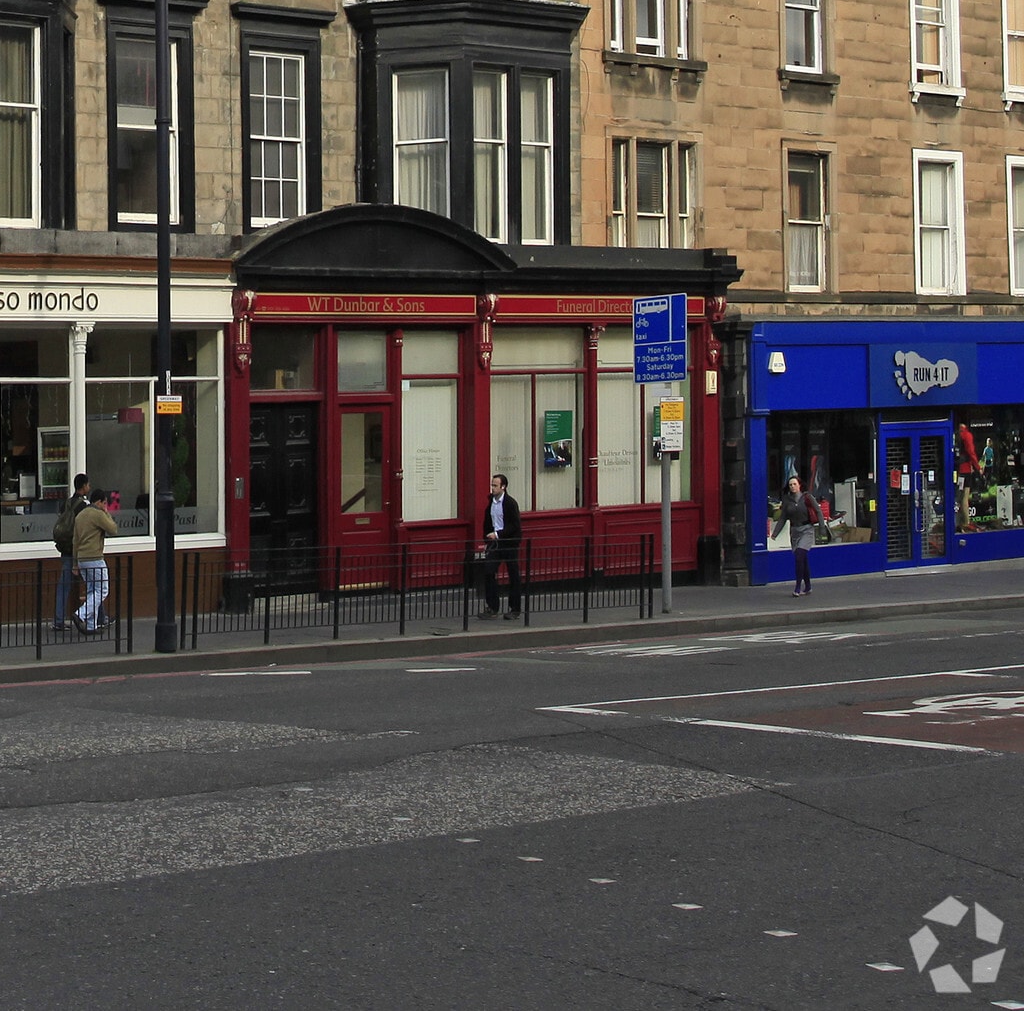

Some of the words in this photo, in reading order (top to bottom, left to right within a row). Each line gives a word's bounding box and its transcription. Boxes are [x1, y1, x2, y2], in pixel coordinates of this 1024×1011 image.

[28, 287, 99, 311] mondo
[307, 296, 331, 312] WT
[334, 297, 380, 312] Dunbar
[382, 298, 394, 312] &
[396, 298, 425, 312] Sons
[556, 299, 596, 313] Funeral
[647, 346, 672, 354] Mon-Fri
[646, 363, 674, 371] Saturday
[913, 368, 931, 382] RUN
[933, 368, 939, 382] 4
[941, 367, 949, 382] IT
